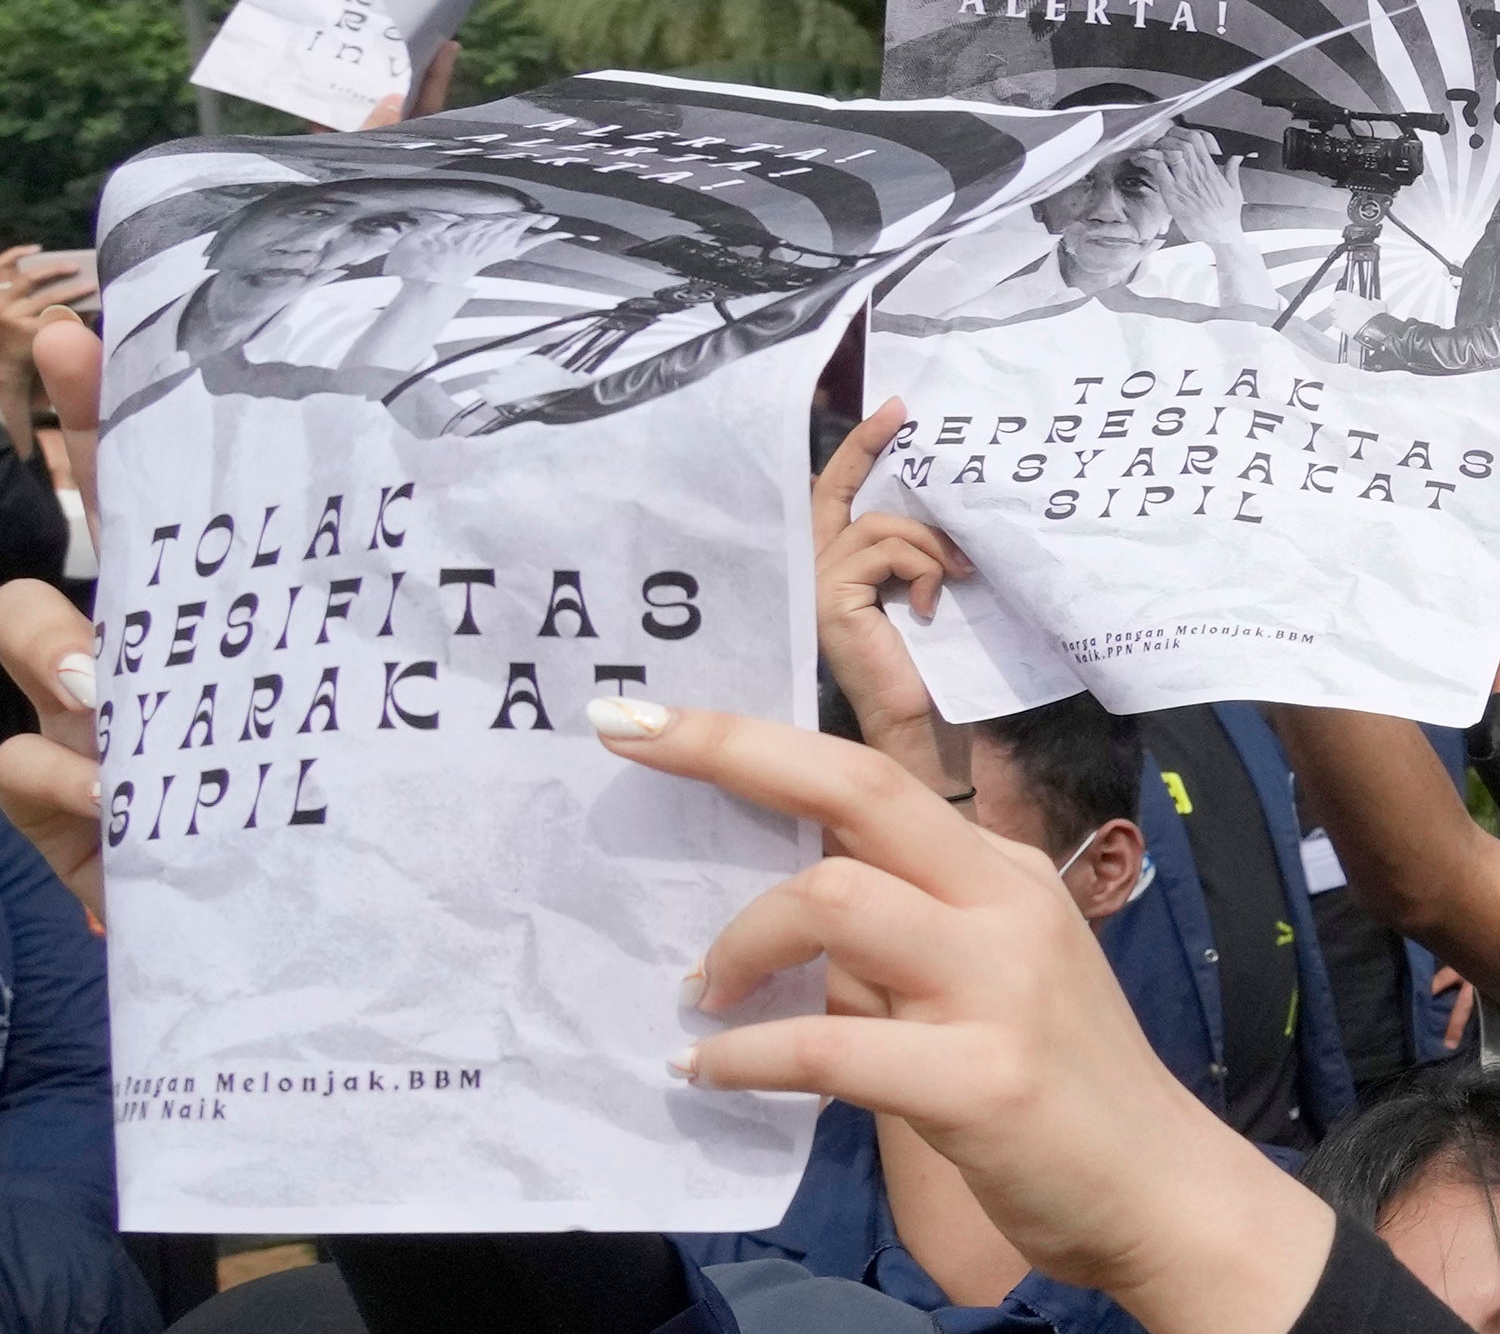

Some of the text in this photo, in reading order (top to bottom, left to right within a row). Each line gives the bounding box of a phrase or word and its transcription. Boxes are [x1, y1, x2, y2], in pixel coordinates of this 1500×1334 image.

[453, 133, 813, 178] ALERTA!
[524, 118, 877, 164] ALERTA!
[385, 141, 746, 191] ALERTA!
[1073, 368, 1325, 412] TOLAK
[888, 406, 1495, 481] REPRESIFITAS
[900, 445, 1457, 511] MASYARAKAT
[1043, 485, 1263, 523] SIPIL
[146, 482, 417, 587] TOLAK
[1106, 628, 1164, 645] Pangan
[1176, 624, 1315, 644] Melonjak.BBM
[1143, 638, 1181, 653] Naik
[106, 759, 328, 847] SIPIL
[216, 1069, 482, 1096] Melonjak.BBM
[161, 1099, 226, 1120] Naik
